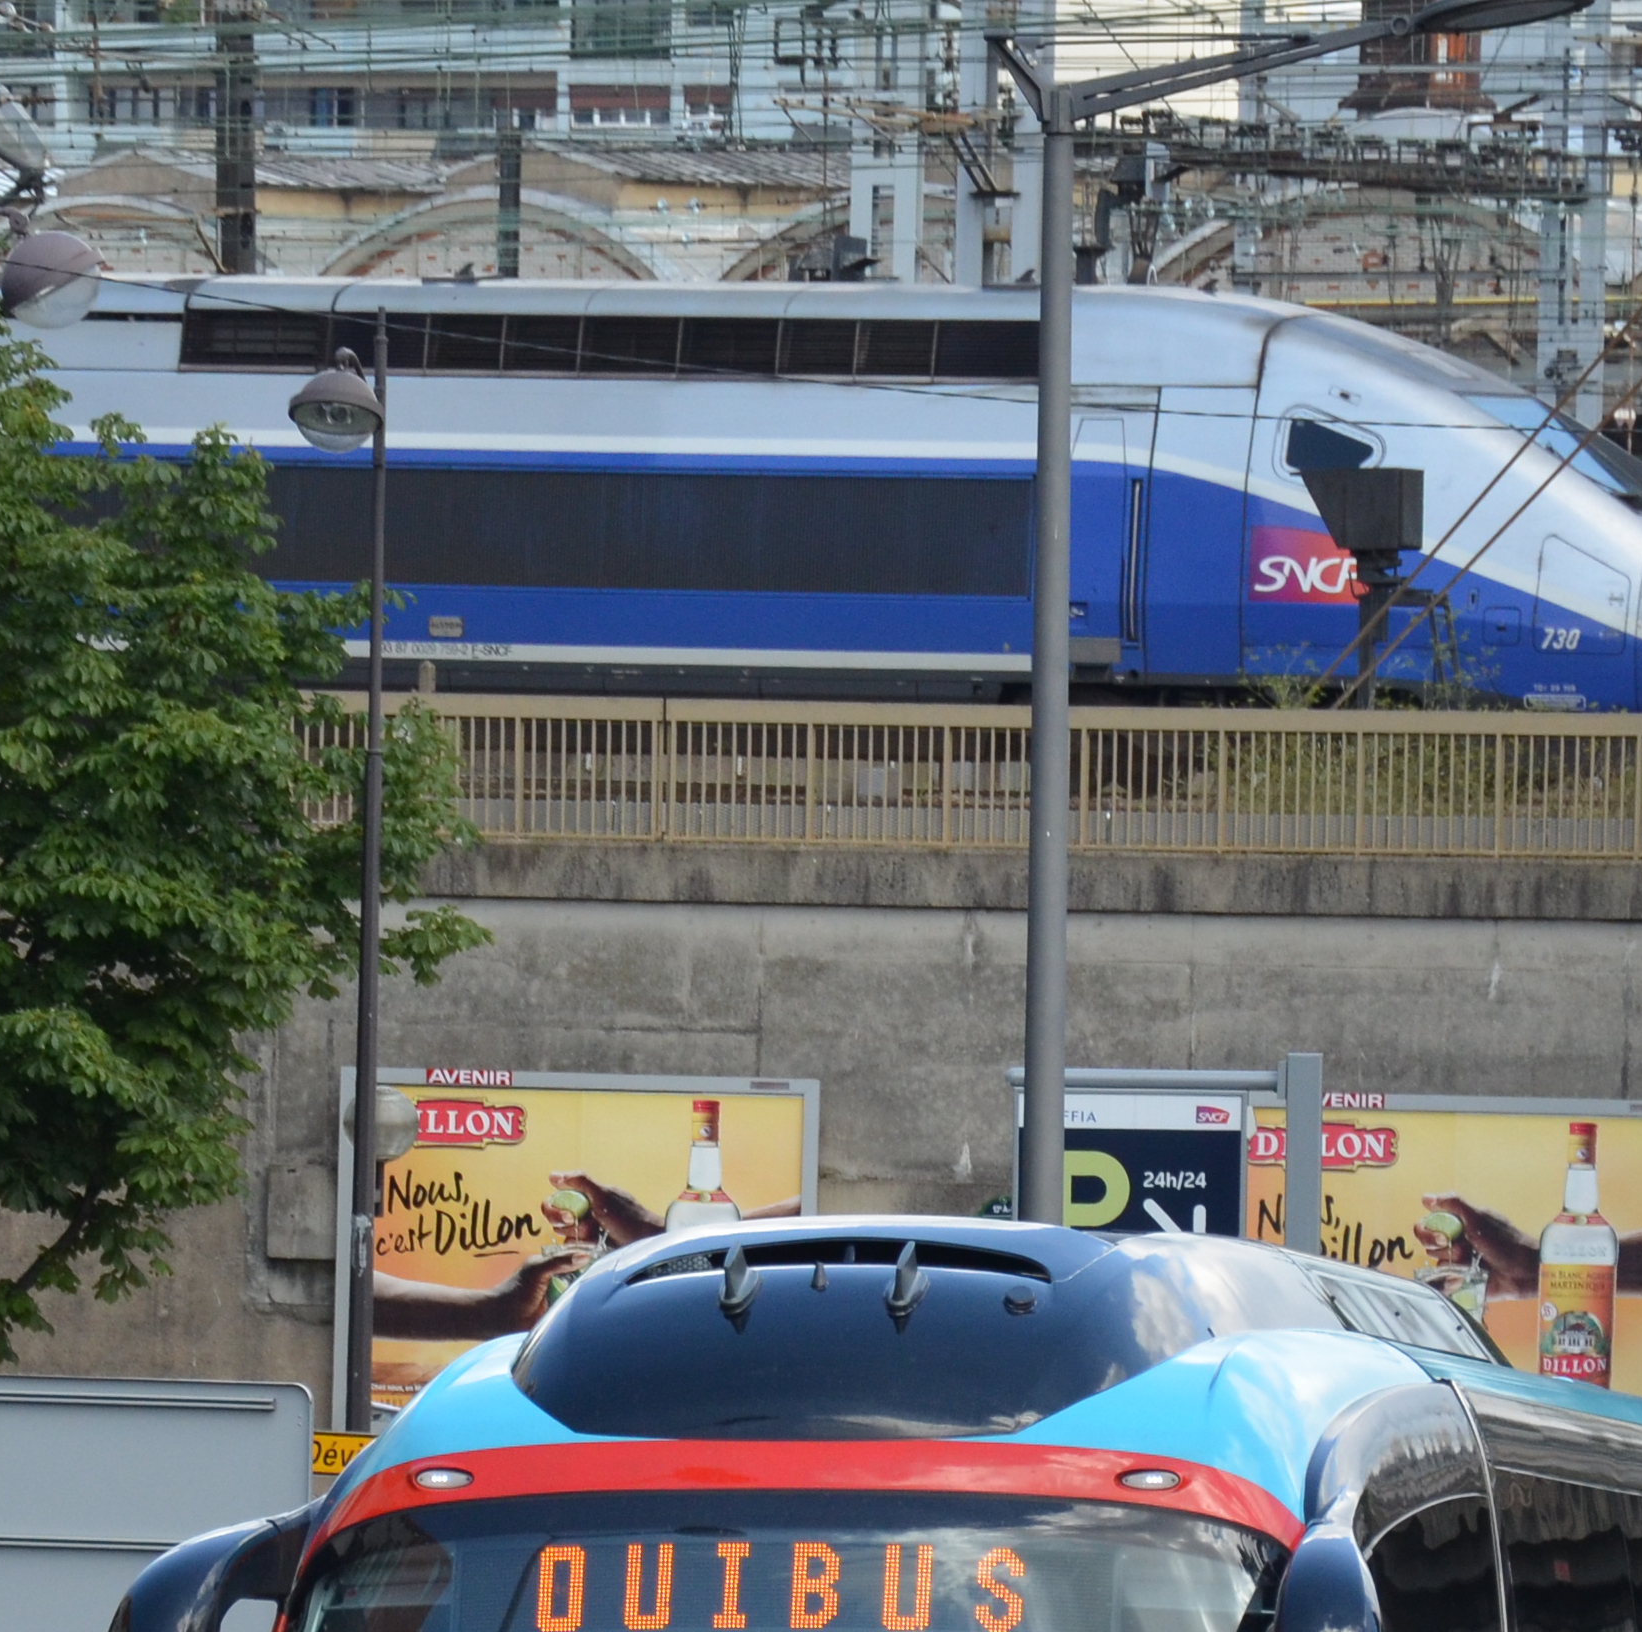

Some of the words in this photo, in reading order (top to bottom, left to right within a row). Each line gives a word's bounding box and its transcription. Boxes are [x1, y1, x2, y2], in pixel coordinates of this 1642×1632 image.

[1254, 555, 1357, 593] SNCF
[1542, 628, 1581, 650] 730
[429, 1070, 511, 1085] AVENIR
[1323, 1093, 1383, 1108] ENIR
[417, 1110, 515, 1136] ILLON
[1064, 1110, 1097, 1122] FFIA
[1197, 1112, 1228, 1122] SNCF
[1256, 1133, 1386, 1158] DLON
[1143, 1171, 1206, 1190] 24h/24
[388, 1169, 469, 1213] Nous,
[435, 1200, 541, 1255] Dillon
[1543, 1356, 1607, 1375] DILLON
